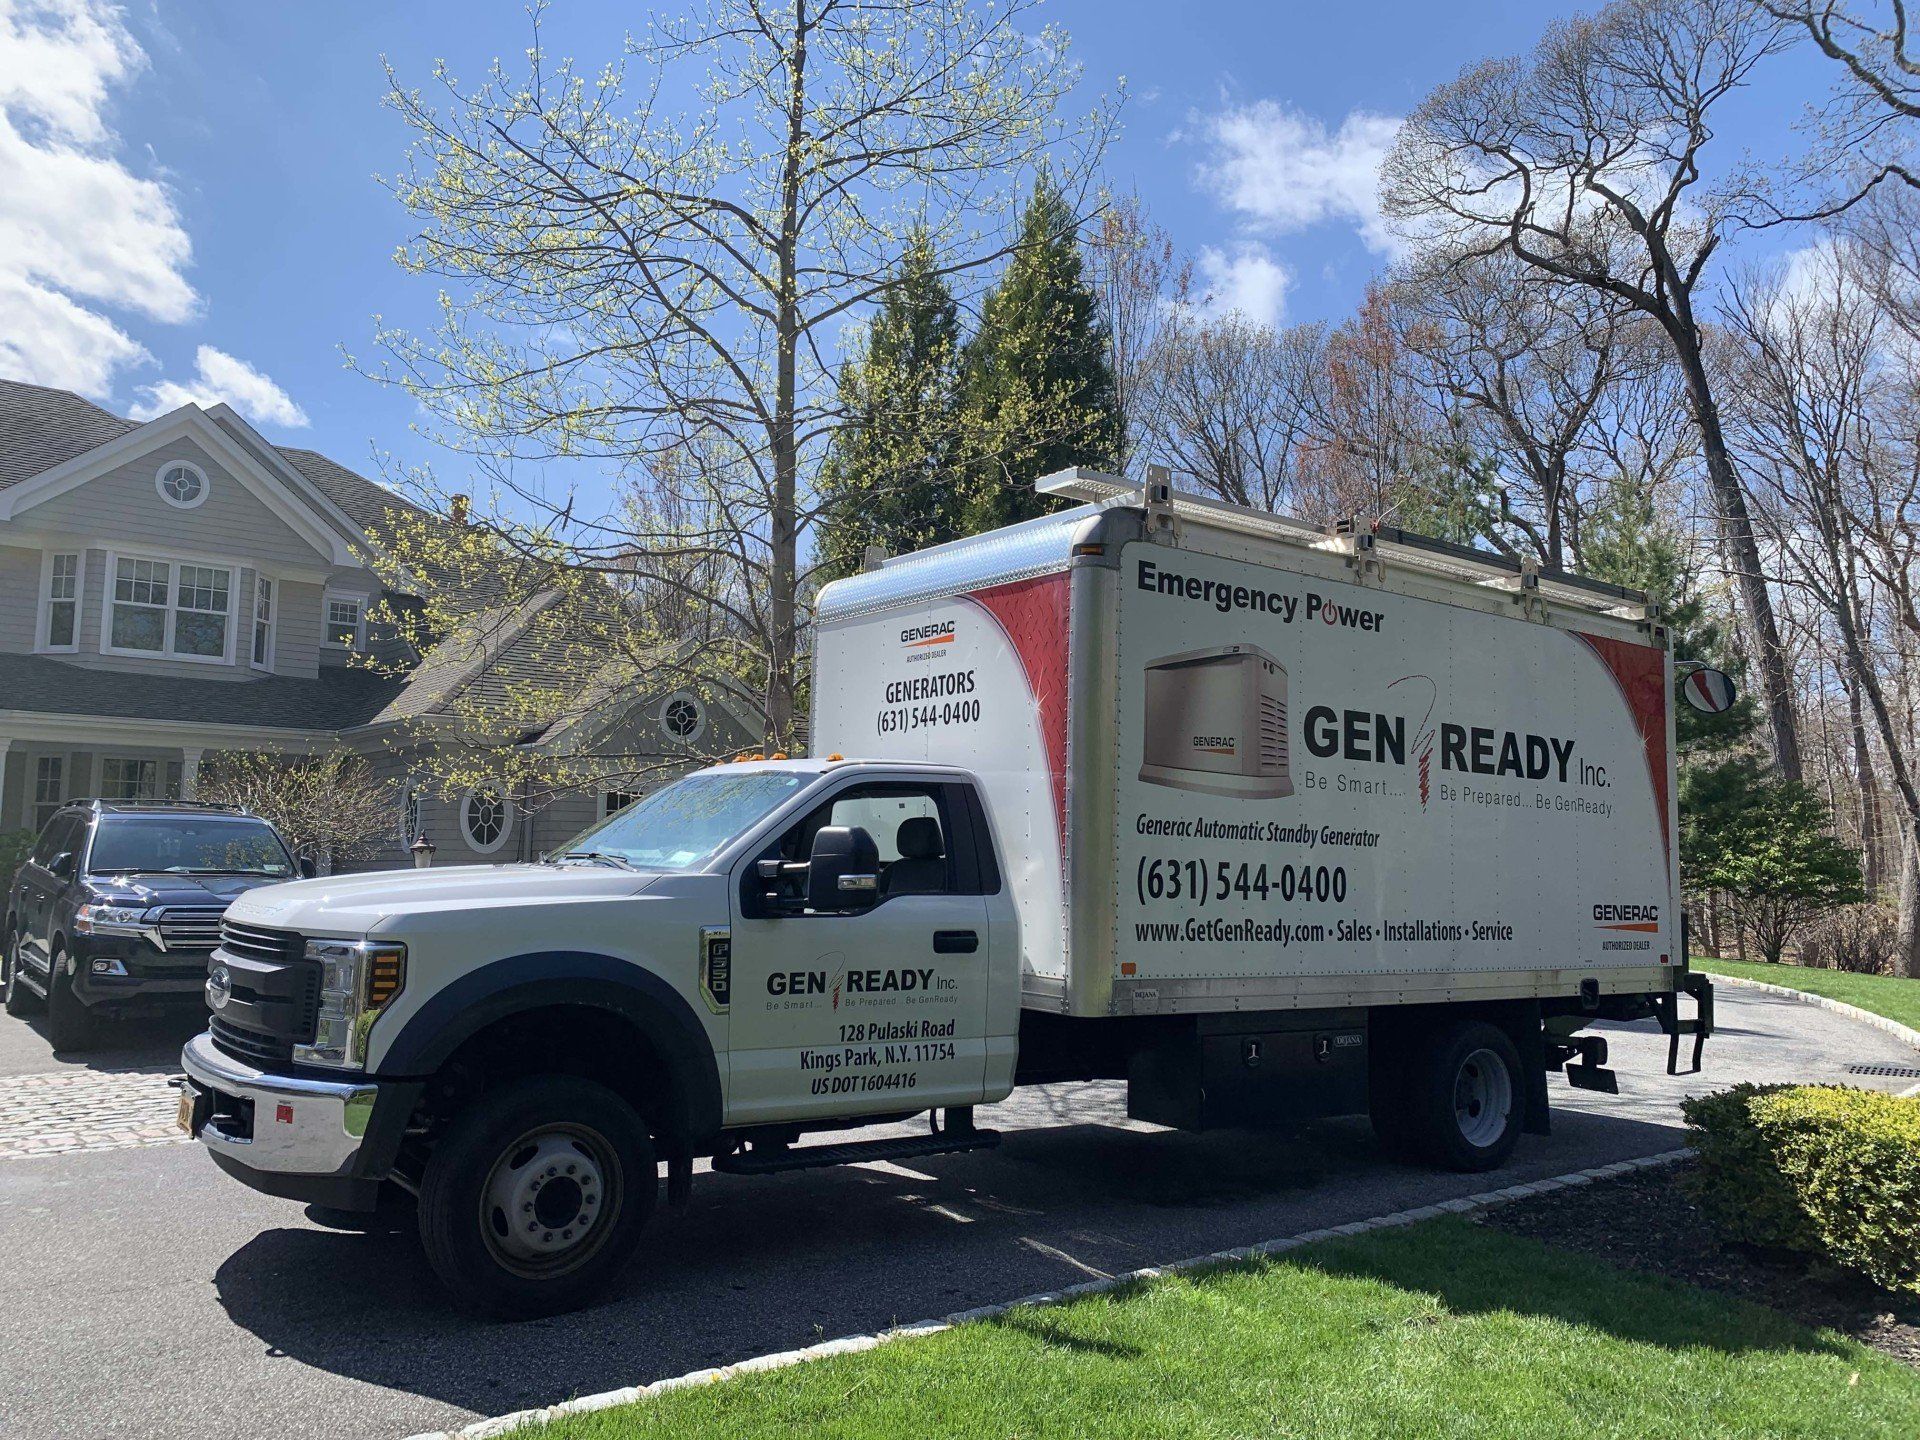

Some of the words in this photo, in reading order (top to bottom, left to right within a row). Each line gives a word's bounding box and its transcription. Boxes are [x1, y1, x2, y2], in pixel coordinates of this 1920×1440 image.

[1138, 559, 1298, 624] Emergency
[1306, 592, 1385, 633] Power
[901, 620, 955, 642] GENERAC
[906, 652, 931, 663] AUTHORIZED
[931, 649, 947, 660] DEALER
[885, 669, 975, 704] GENERATORS
[877, 707, 908, 736] (631)
[911, 699, 981, 729] 544-0400
[1193, 736, 1235, 748] GENERAC
[1303, 705, 1405, 766] GEN
[1441, 722, 1576, 783] READY
[1580, 757, 1611, 788] Inc.
[1305, 771, 1327, 790] Be
[1440, 784, 1457, 802] Be
[1536, 793, 1551, 810] Be
[1555, 795, 1612, 819] GenReady
[1136, 813, 1192, 838] Generac
[1194, 817, 1264, 842] Automatic
[1267, 821, 1318, 849] Standby
[1320, 825, 1380, 848] Generator
[1137, 856, 1209, 907] (631)
[1216, 861, 1347, 903] 544-0400
[1593, 904, 1659, 922] GENERAC
[1135, 917, 1324, 949] www.GetGenReady.com
[1336, 919, 1373, 942] Sales
[1384, 919, 1462, 942] Installations
[1471, 920, 1513, 941] Service
[1602, 940, 1632, 951] AUTHORIZED
[1633, 940, 1651, 951] DEALER
[766, 971, 827, 996] GEN
[846, 968, 935, 993] READY
[936, 975, 959, 991] Inc.
[766, 1002, 780, 1011] Be
[845, 998, 856, 1007] Be
[905, 995, 916, 1005] Be
[918, 995, 959, 1005] GenReady
[839, 1024, 865, 1042] 128
[868, 1020, 918, 1041] Pulaski
[921, 1018, 956, 1038] Road
[800, 1050, 842, 1073] Kings
[845, 1047, 882, 1067] Park,
[885, 1044, 911, 1064] N.Y.
[914, 1042, 956, 1062] 11754
